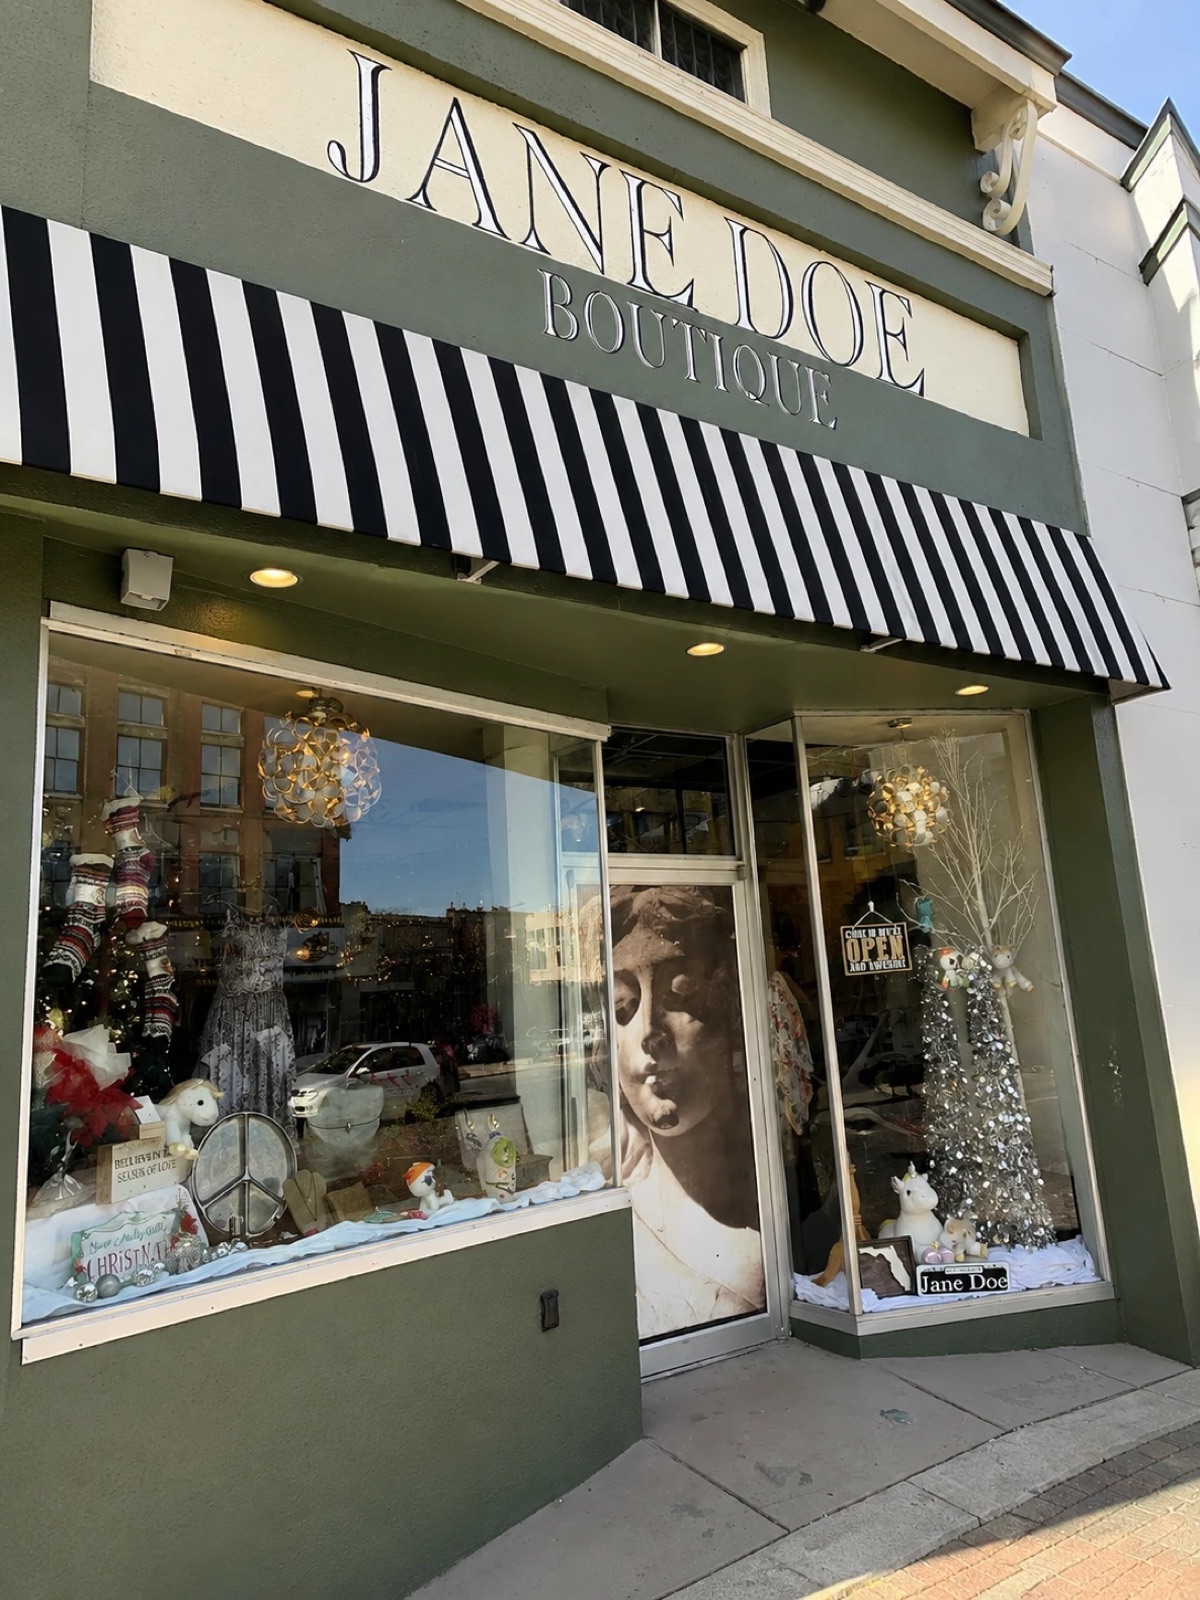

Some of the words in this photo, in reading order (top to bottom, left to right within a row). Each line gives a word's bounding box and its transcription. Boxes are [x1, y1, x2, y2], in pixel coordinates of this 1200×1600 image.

[327, 49, 699, 312] JANE
[724, 216, 926, 397] DOE
[536, 268, 838, 430] BOUTIQUE
[846, 935, 905, 963] OPEN
[920, 1275, 963, 1293] Jane
[968, 1273, 1009, 1291] Doe
